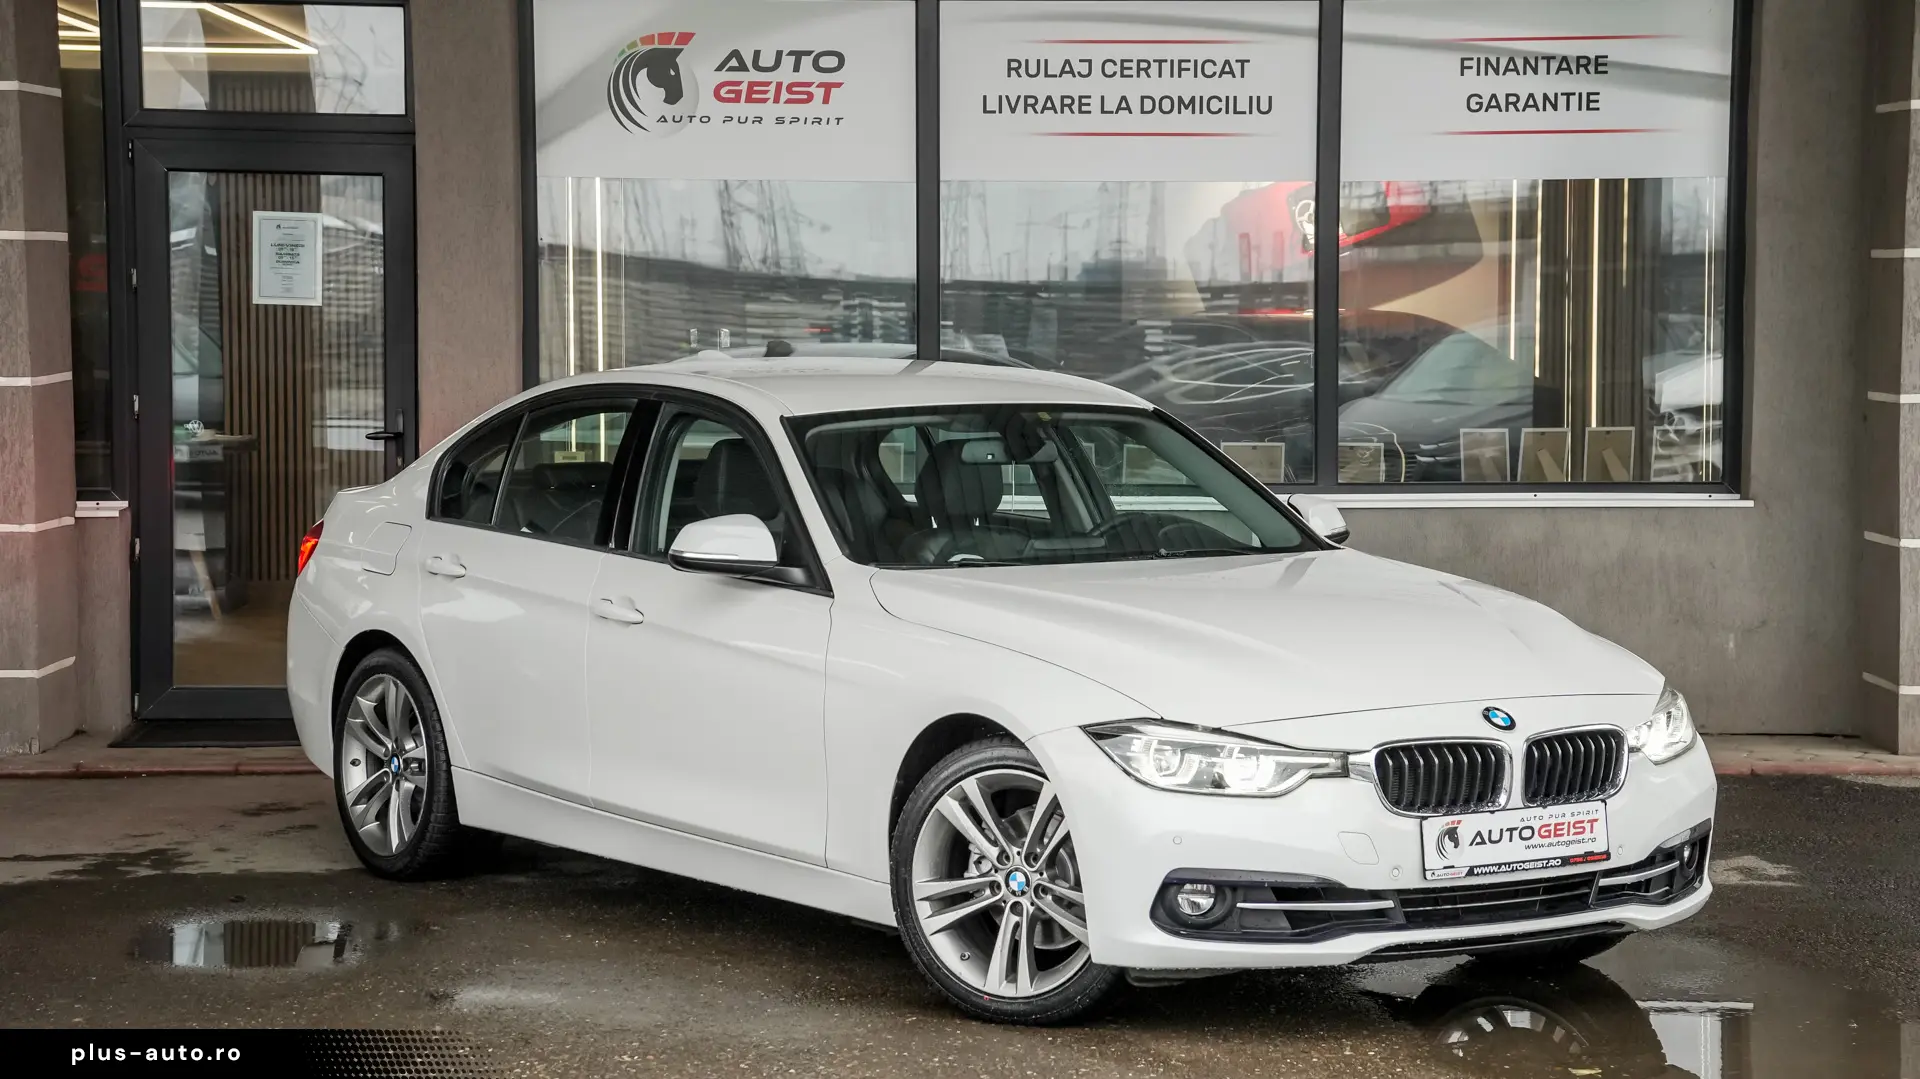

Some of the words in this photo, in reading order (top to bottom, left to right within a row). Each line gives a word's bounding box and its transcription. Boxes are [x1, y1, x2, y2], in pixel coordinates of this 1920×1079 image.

[714, 49, 845, 73] AUTO
[1006, 58, 1093, 78] RULAJ
[1101, 58, 1251, 79] CERTIFICAT
[1460, 55, 1609, 76] FINANTARE
[713, 81, 845, 105] GEIST
[1466, 92, 1601, 113] GARANTIE
[982, 95, 1092, 115] LIVRARE
[1100, 95, 1133, 115] LA
[1140, 95, 1273, 115] DOMICILIU
[656, 115, 711, 124] AUTO
[722, 116, 763, 125] PUR
[775, 116, 844, 126] SPIRIT
[1519, 815, 1544, 823] AUTO
[1548, 812, 1566, 820] PUR
[1570, 809, 1599, 818] SPIRIT
[1524, 837, 1597, 850] www.autogeist.ro
[1473, 858, 1562, 875] WWW.AUTOGEIST.RO
